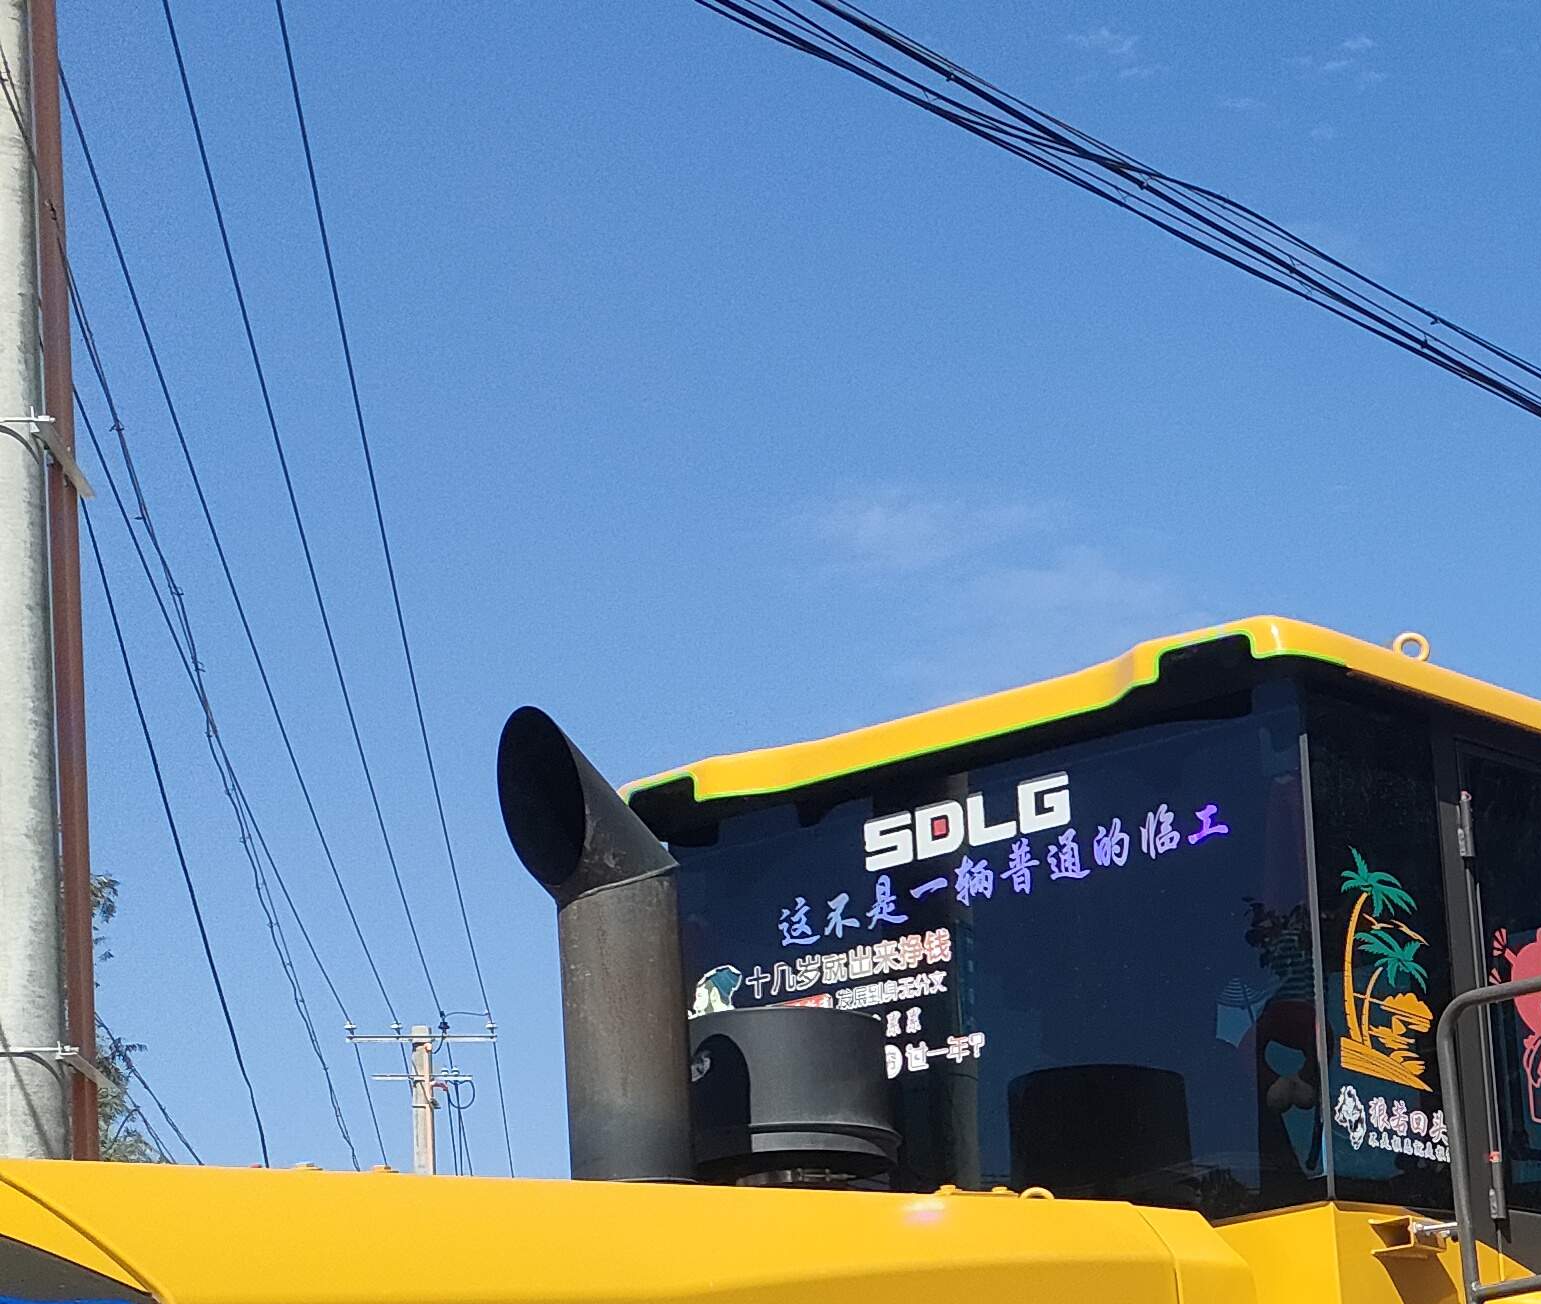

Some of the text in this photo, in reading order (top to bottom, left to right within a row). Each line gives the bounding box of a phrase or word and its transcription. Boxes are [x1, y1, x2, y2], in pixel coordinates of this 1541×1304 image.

[864, 772, 1070, 872] SDLG
[779, 803, 1229, 947] 这不是一辆普通的临工
[746, 928, 952, 999] 十几岁就出来挣钱
